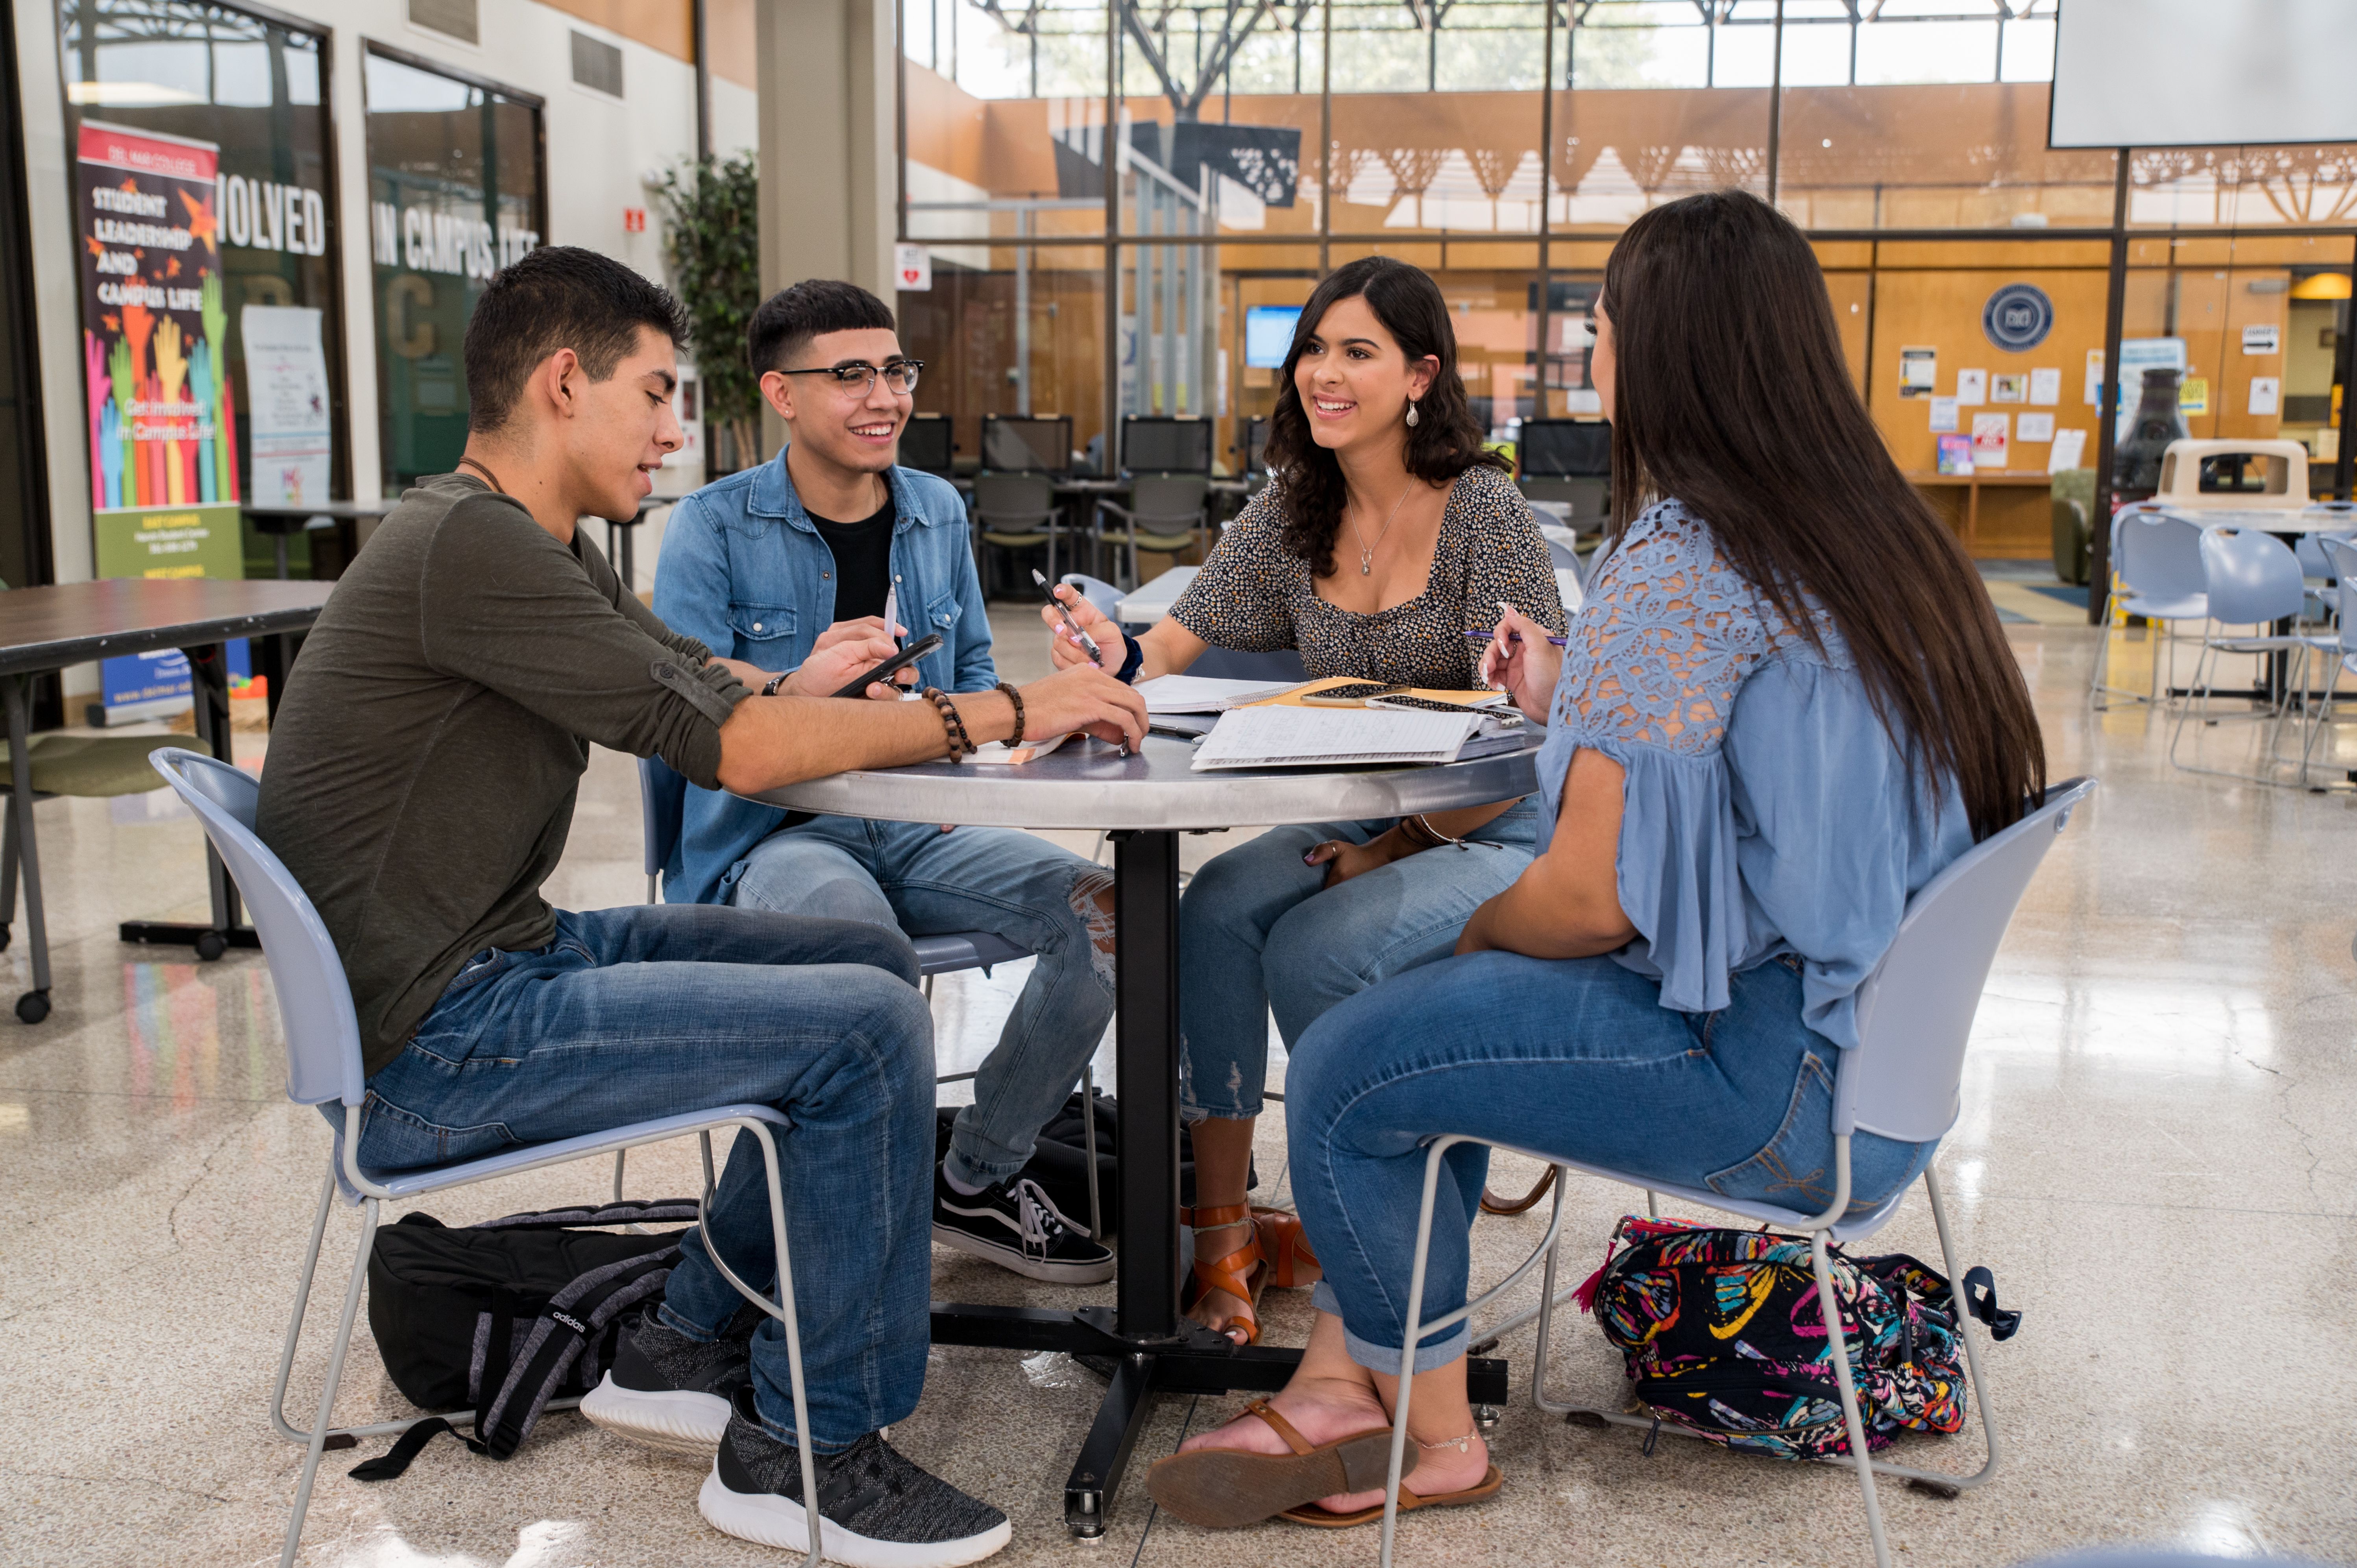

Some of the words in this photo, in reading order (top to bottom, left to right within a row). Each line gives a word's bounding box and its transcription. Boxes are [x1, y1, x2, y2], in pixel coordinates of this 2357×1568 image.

[92, 186, 167, 218] STUDENT
[94, 218, 192, 251] LEADERSHIP
[404, 207, 494, 279] CAMPUS
[96, 249, 138, 275] AND
[97, 281, 166, 309] CAMPUS
[166, 287, 203, 312] LIFE
[553, 1311, 585, 1333] adidas
